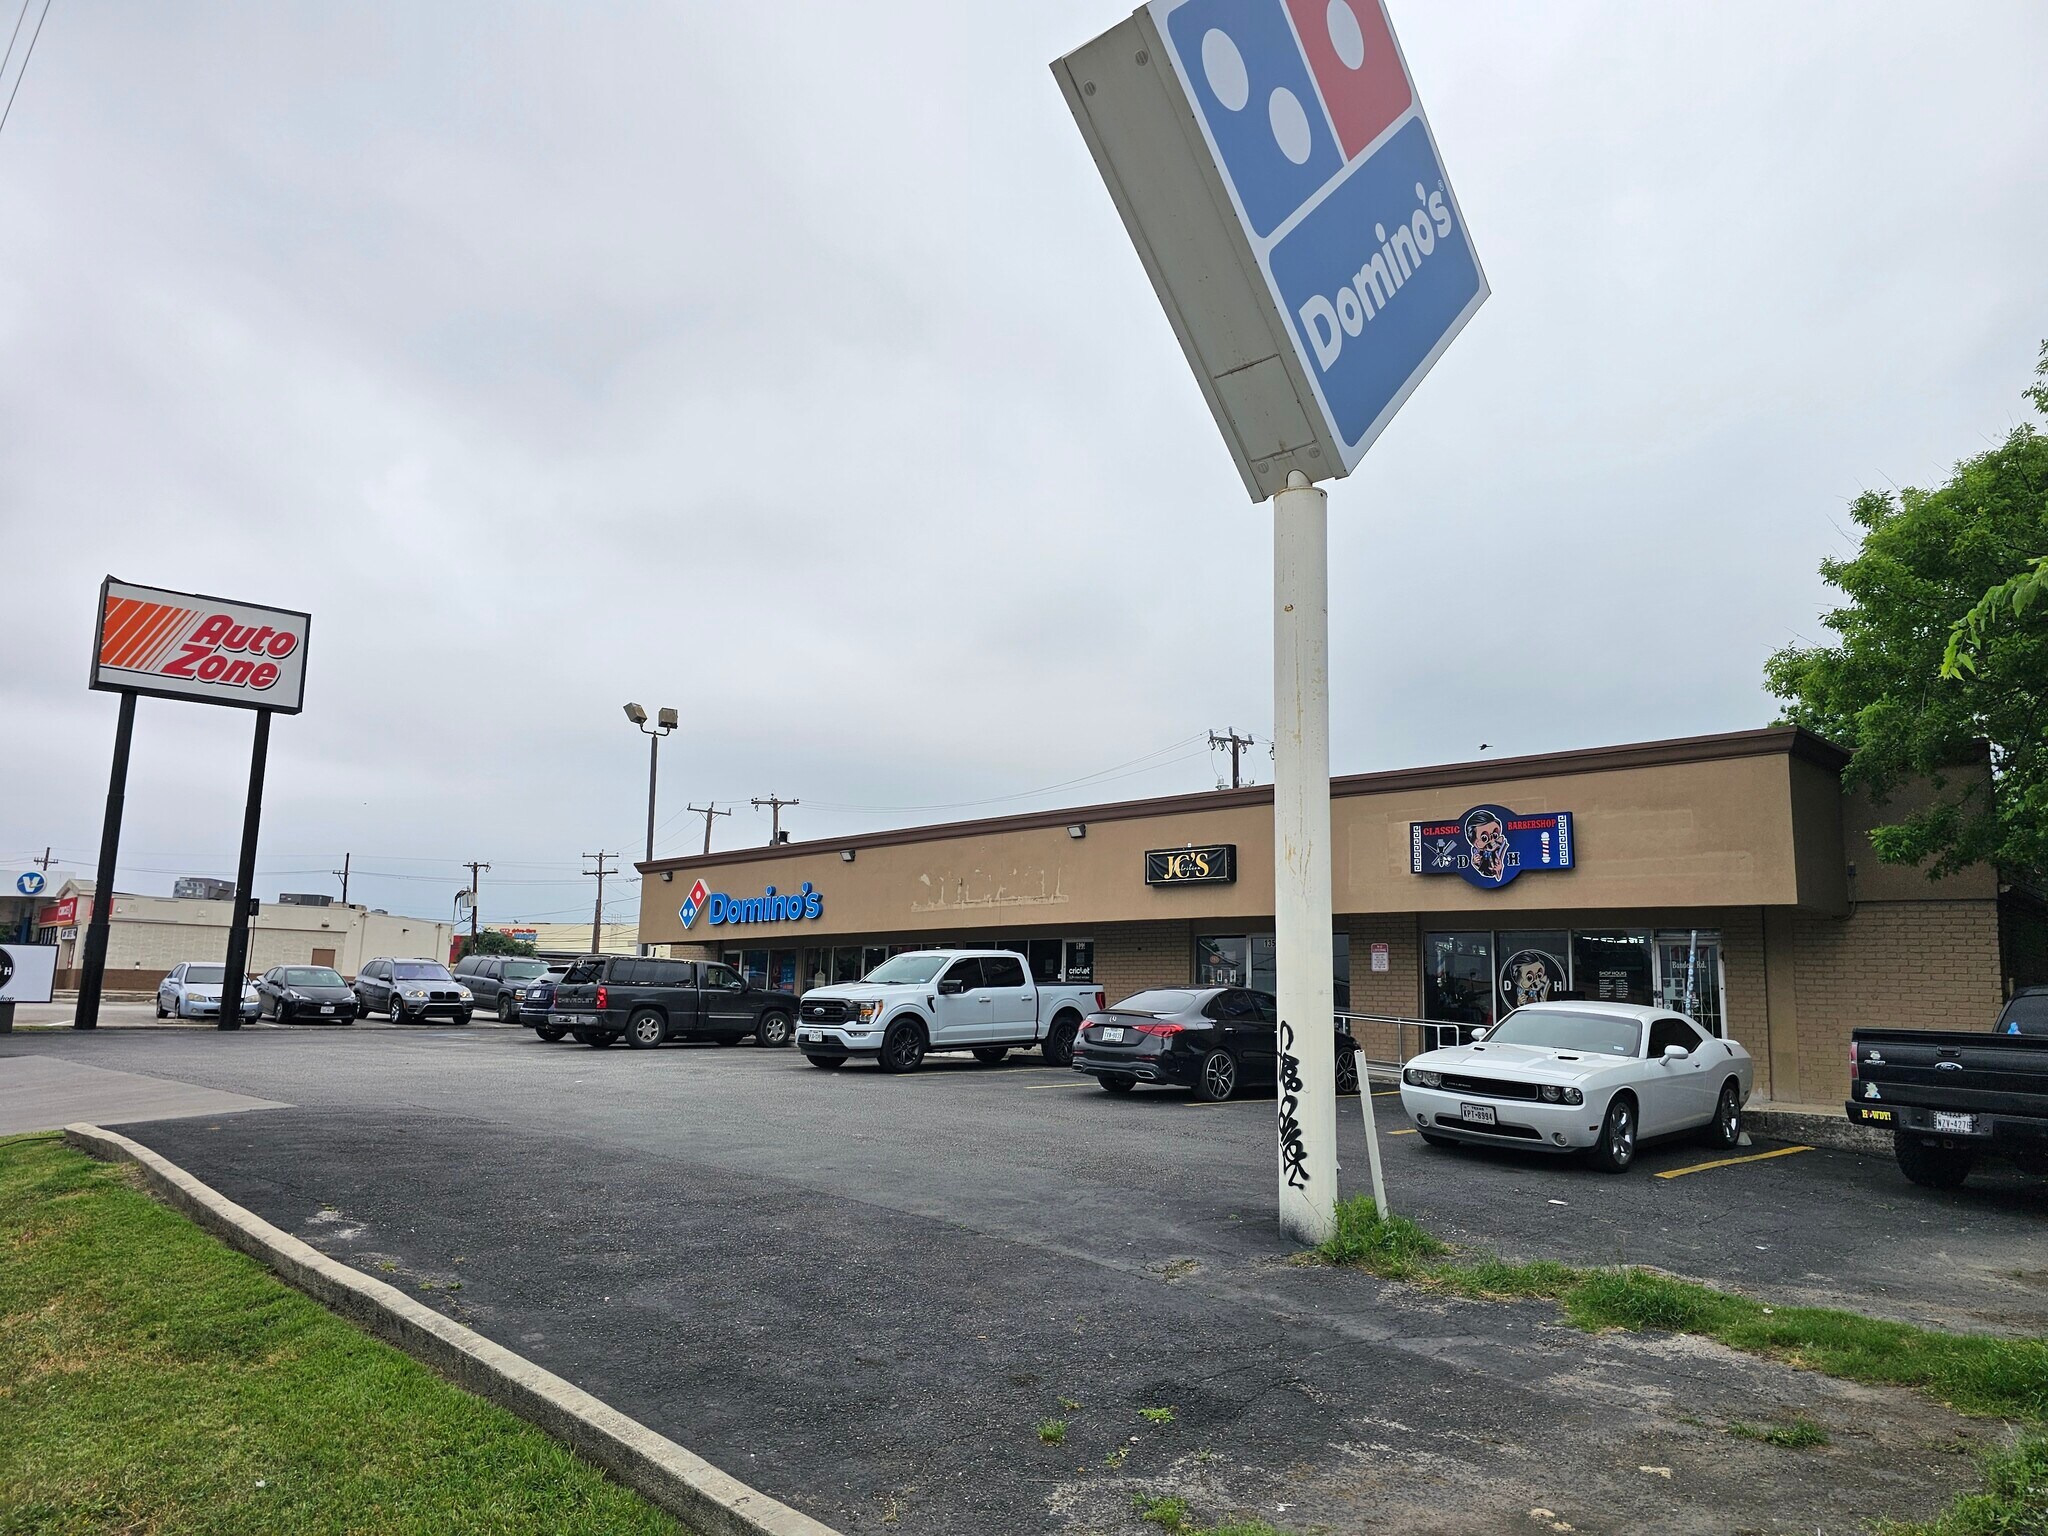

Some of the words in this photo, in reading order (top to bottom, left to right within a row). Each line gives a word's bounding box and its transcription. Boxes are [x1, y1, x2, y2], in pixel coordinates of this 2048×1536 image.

[1298, 181, 1452, 373] Domino's
[187, 614, 298, 657] Auto
[160, 643, 280, 689] Zone
[1423, 825, 1461, 836] CLASSIC
[1507, 819, 1557, 831] BARBERSHOP
[1163, 851, 1210, 880] JC'S
[1457, 854, 1470, 869] D
[1507, 851, 1521, 867] H
[708, 881, 823, 925] Domino's
[3, 966, 12, 976] H
[1504, 980, 1512, 991] D
[1553, 980, 1563, 992] H
[1462, 1109, 1493, 1122] KPT-8994
[1861, 1108, 1891, 1121] HWDY!
